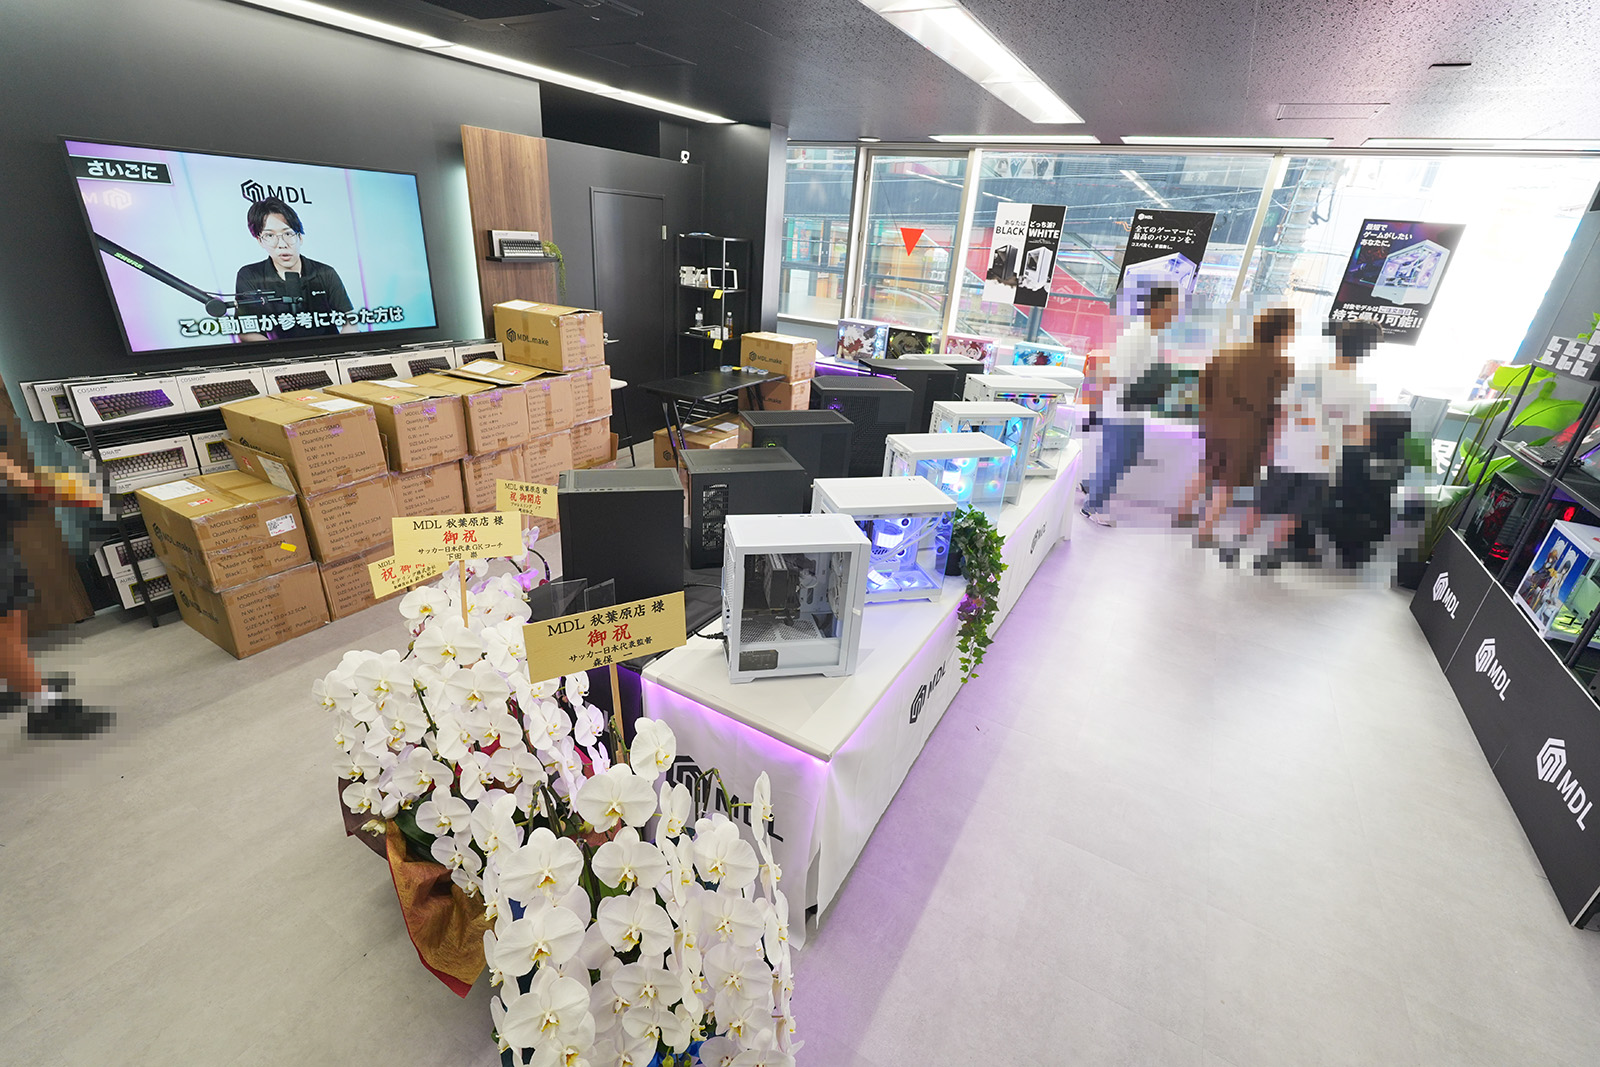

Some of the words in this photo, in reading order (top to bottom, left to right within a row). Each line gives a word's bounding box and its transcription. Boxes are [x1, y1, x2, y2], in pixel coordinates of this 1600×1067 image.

[87, 160, 158, 180] さいごに
[268, 186, 312, 204] MDL
[996, 226, 1025, 236] BLACK
[1028, 228, 1060, 238] WHITE
[1132, 232, 1194, 244] 最高のパソコンを。
[1135, 225, 1196, 236] 全てのゲーマーに、
[1363, 231, 1413, 240] ゲームがしたい
[1360, 239, 1390, 247] あなたに。
[114, 252, 144, 270] SHURE
[179, 306, 404, 337] この動画が参考になった方は
[180, 376, 200, 384] COSMO
[77, 386, 100, 394] COSMO
[299, 424, 340, 436] MODEL:COSMO
[510, 491, 517, 502] 祝
[210, 514, 257, 529] MODEL:COSMO
[413, 520, 442, 530] MDL
[446, 516, 489, 528] 秋葉原店
[493, 515, 504, 526] 様
[212, 523, 256, 538] Quantity:20pcs
[442, 530, 477, 544] 御祝
[418, 542, 503, 554] サッカー日本代表GKコーチ
[222, 562, 239, 570] Made
[247, 555, 264, 563] China
[225, 570, 240, 578] Black
[381, 567, 397, 582] 祝
[1442, 587, 1460, 619] MDL
[547, 619, 585, 637] MDL
[590, 604, 646, 627] 秋葉原店
[651, 600, 665, 613] 様
[248, 630, 263, 638] Made
[271, 622, 286, 630] China
[587, 624, 632, 647] 御祝
[569, 636, 653, 663] サッカー日本代表監督
[593, 655, 614, 667] 森保
[927, 660, 946, 699] MDL
[1487, 659, 1511, 701] MDL
[1556, 769, 1593, 831] MDL
